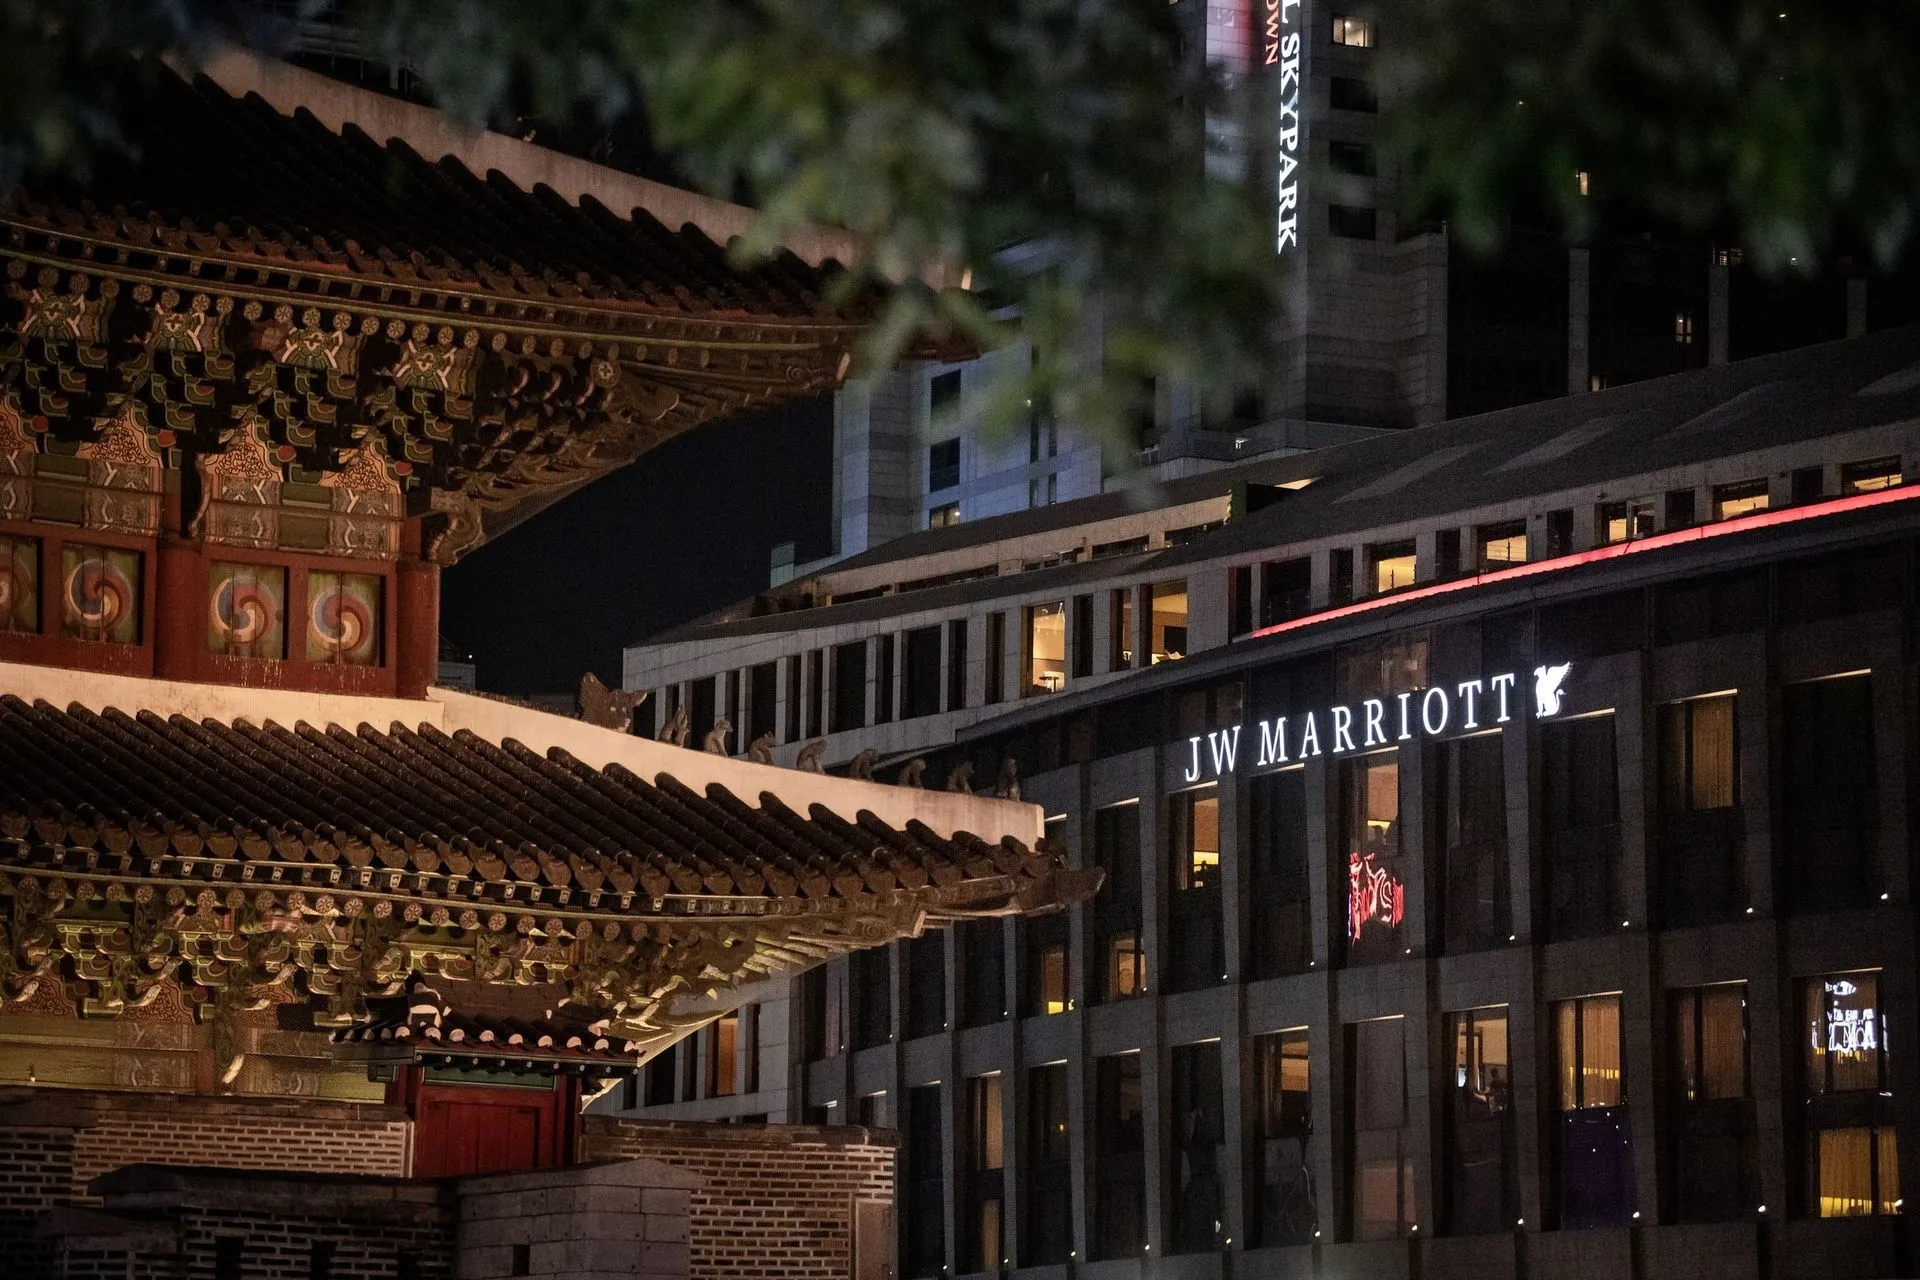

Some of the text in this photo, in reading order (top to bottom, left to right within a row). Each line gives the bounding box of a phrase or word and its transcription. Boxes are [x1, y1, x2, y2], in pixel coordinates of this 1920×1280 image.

[1278, 32, 1300, 255] SKYPARK
[1185, 673, 1515, 782] JW MARRIOTT
